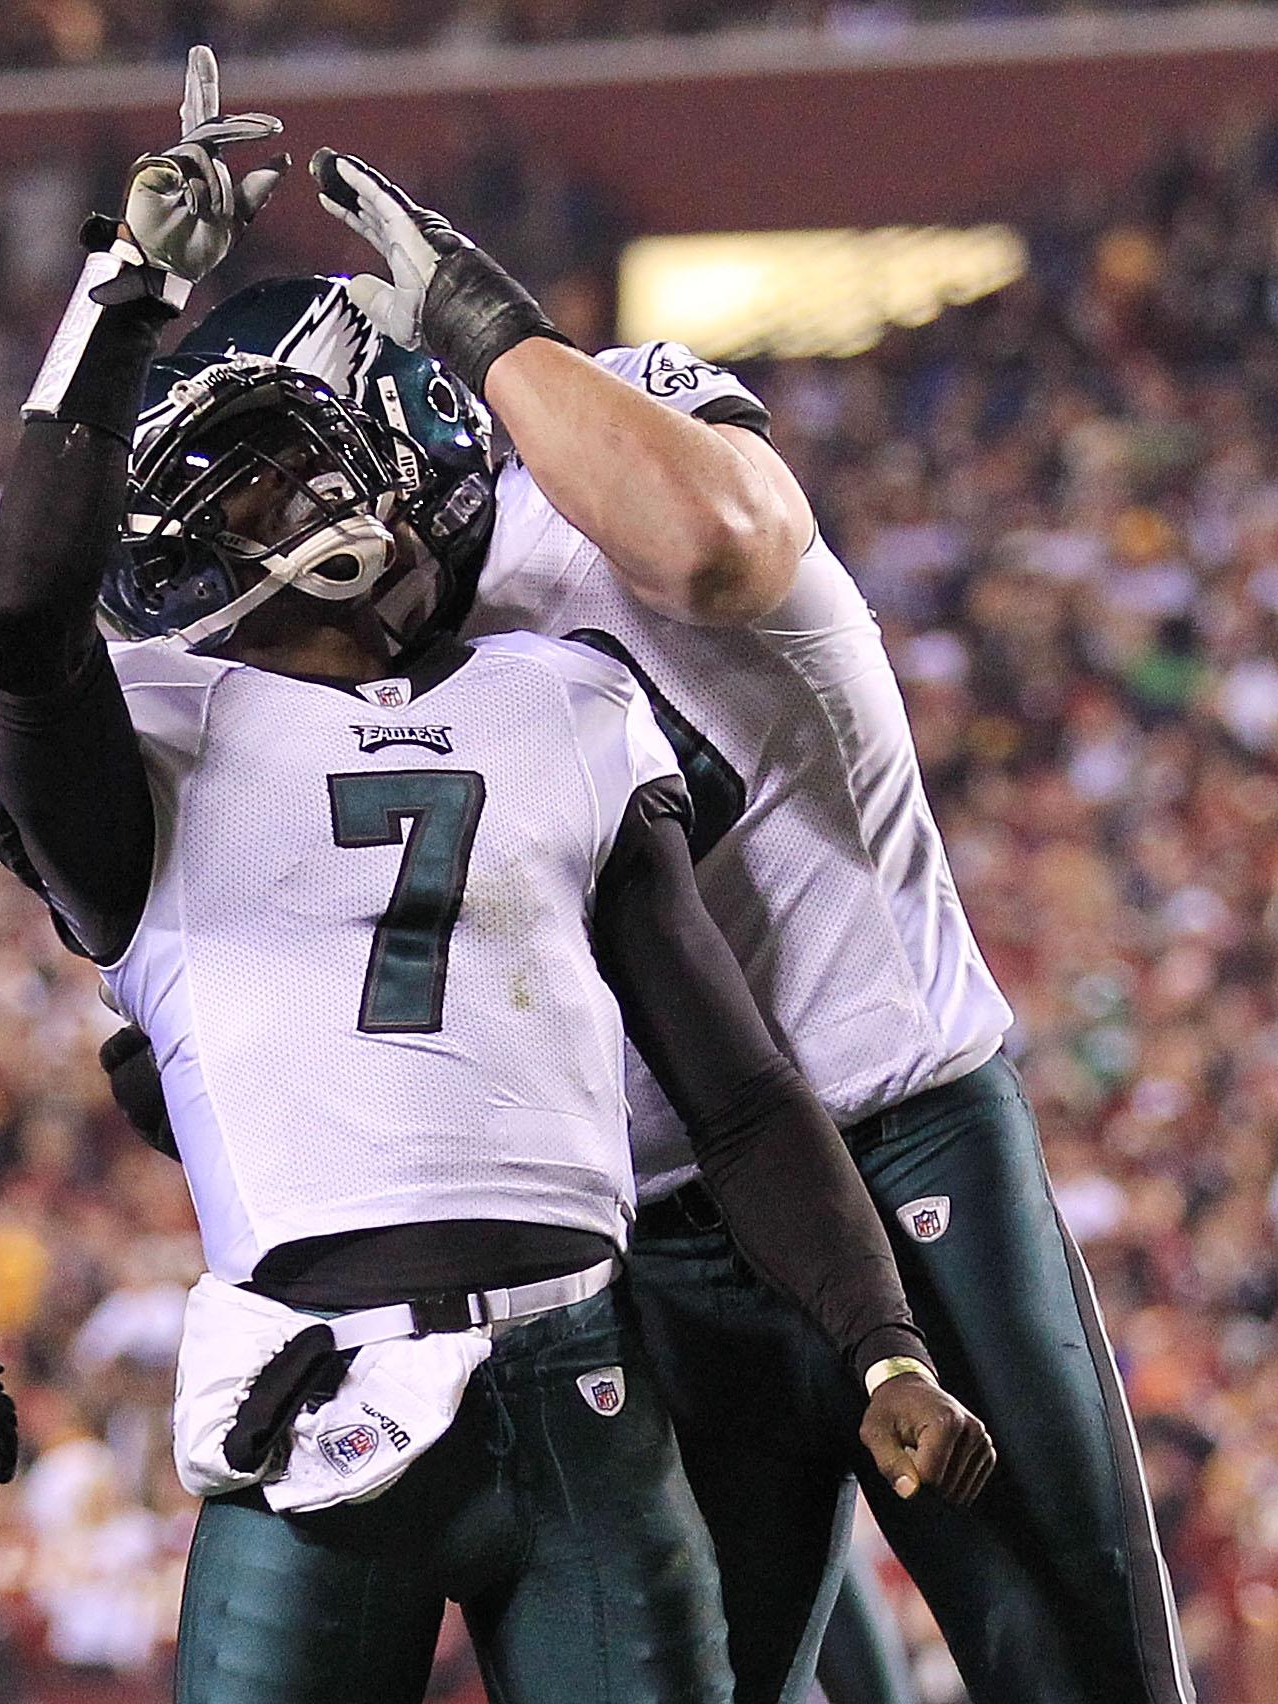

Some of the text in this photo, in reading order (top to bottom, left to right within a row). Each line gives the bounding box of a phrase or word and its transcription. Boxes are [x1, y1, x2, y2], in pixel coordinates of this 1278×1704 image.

[353, 725, 453, 754] EAGLES
[326, 769, 487, 1032] 7
[360, 1401, 411, 1452] Wilson
